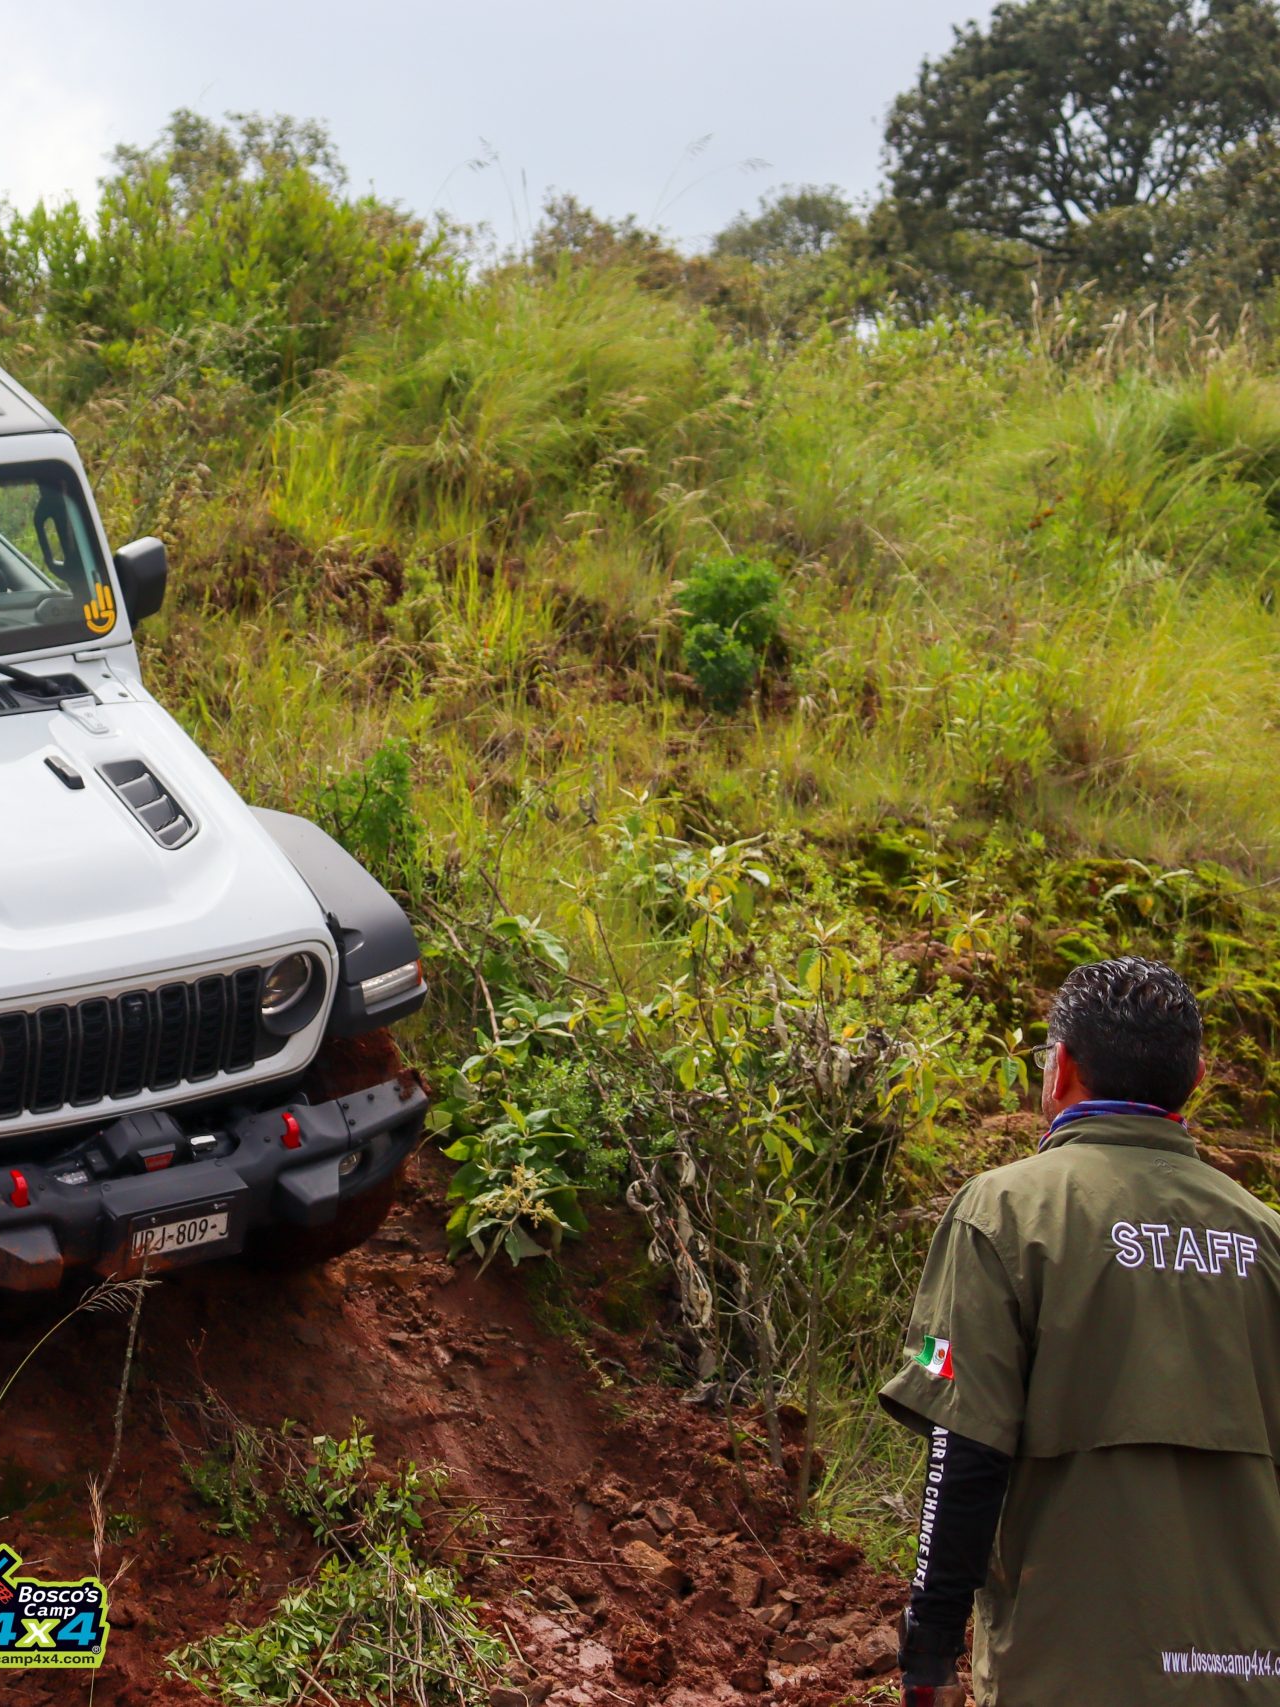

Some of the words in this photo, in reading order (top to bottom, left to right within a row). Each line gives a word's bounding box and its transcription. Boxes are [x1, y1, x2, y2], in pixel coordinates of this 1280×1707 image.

[1111, 1221, 1258, 1278] STAFF
[928, 1463, 944, 1483] TO
[919, 1486, 939, 1556] CHANGE
